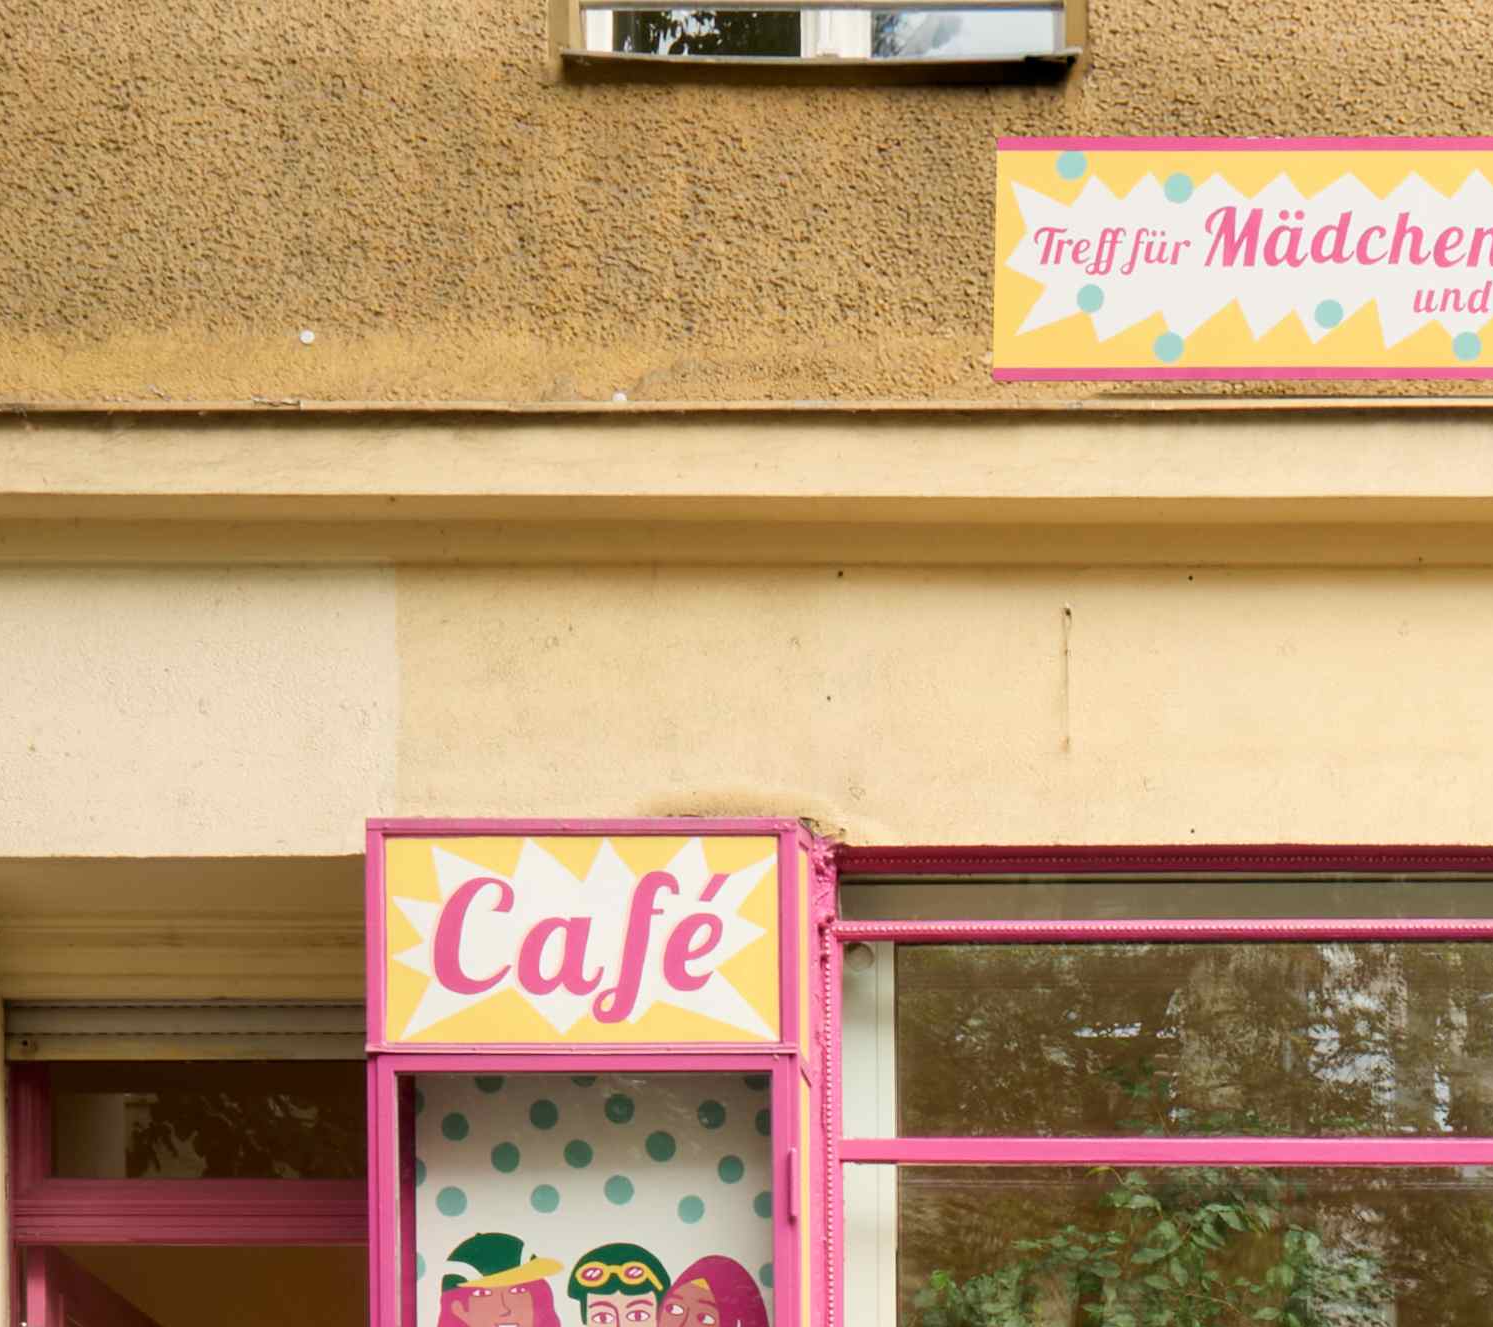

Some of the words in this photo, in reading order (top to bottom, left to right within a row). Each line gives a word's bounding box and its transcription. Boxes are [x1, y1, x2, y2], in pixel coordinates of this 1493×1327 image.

[1033, 226, 1129, 276] Treff
[1120, 228, 1192, 276] für
[1412, 280, 1493, 314] und
[433, 870, 732, 1024] Café
